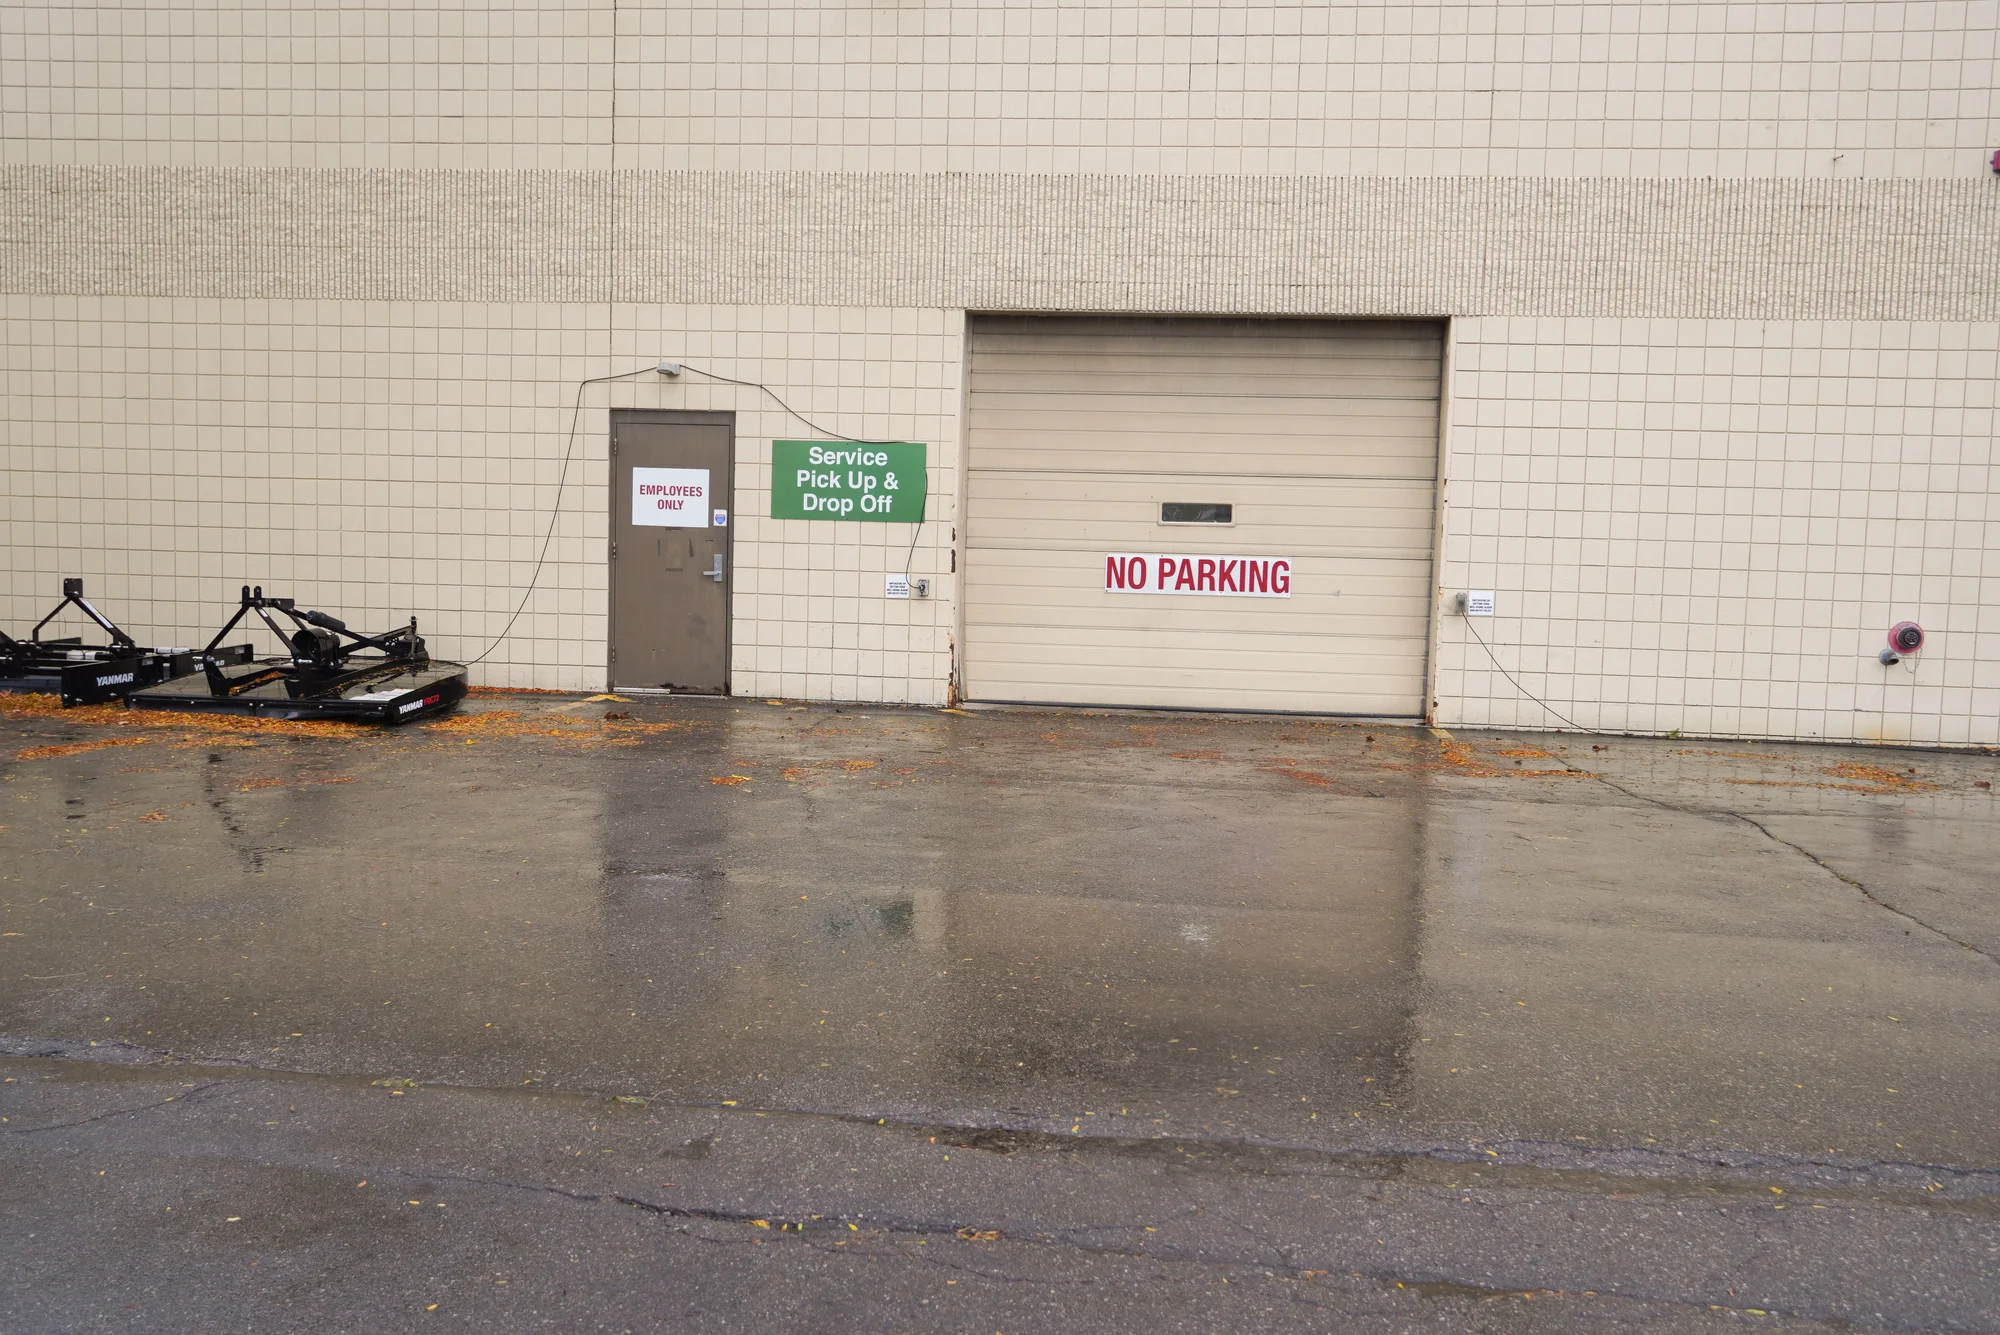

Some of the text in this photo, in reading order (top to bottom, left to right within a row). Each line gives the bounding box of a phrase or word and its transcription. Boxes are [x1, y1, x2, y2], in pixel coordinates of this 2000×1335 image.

[809, 446, 888, 466] Service
[797, 469, 899, 494] Pick Up &
[639, 484, 703, 498] EMPLOYEES
[657, 499, 684, 511] ONLY
[803, 493, 893, 517] Drop Off
[1106, 556, 1290, 594] NO PARKING
[96, 672, 134, 687] YANMAR
[399, 699, 423, 714] YANMAR
